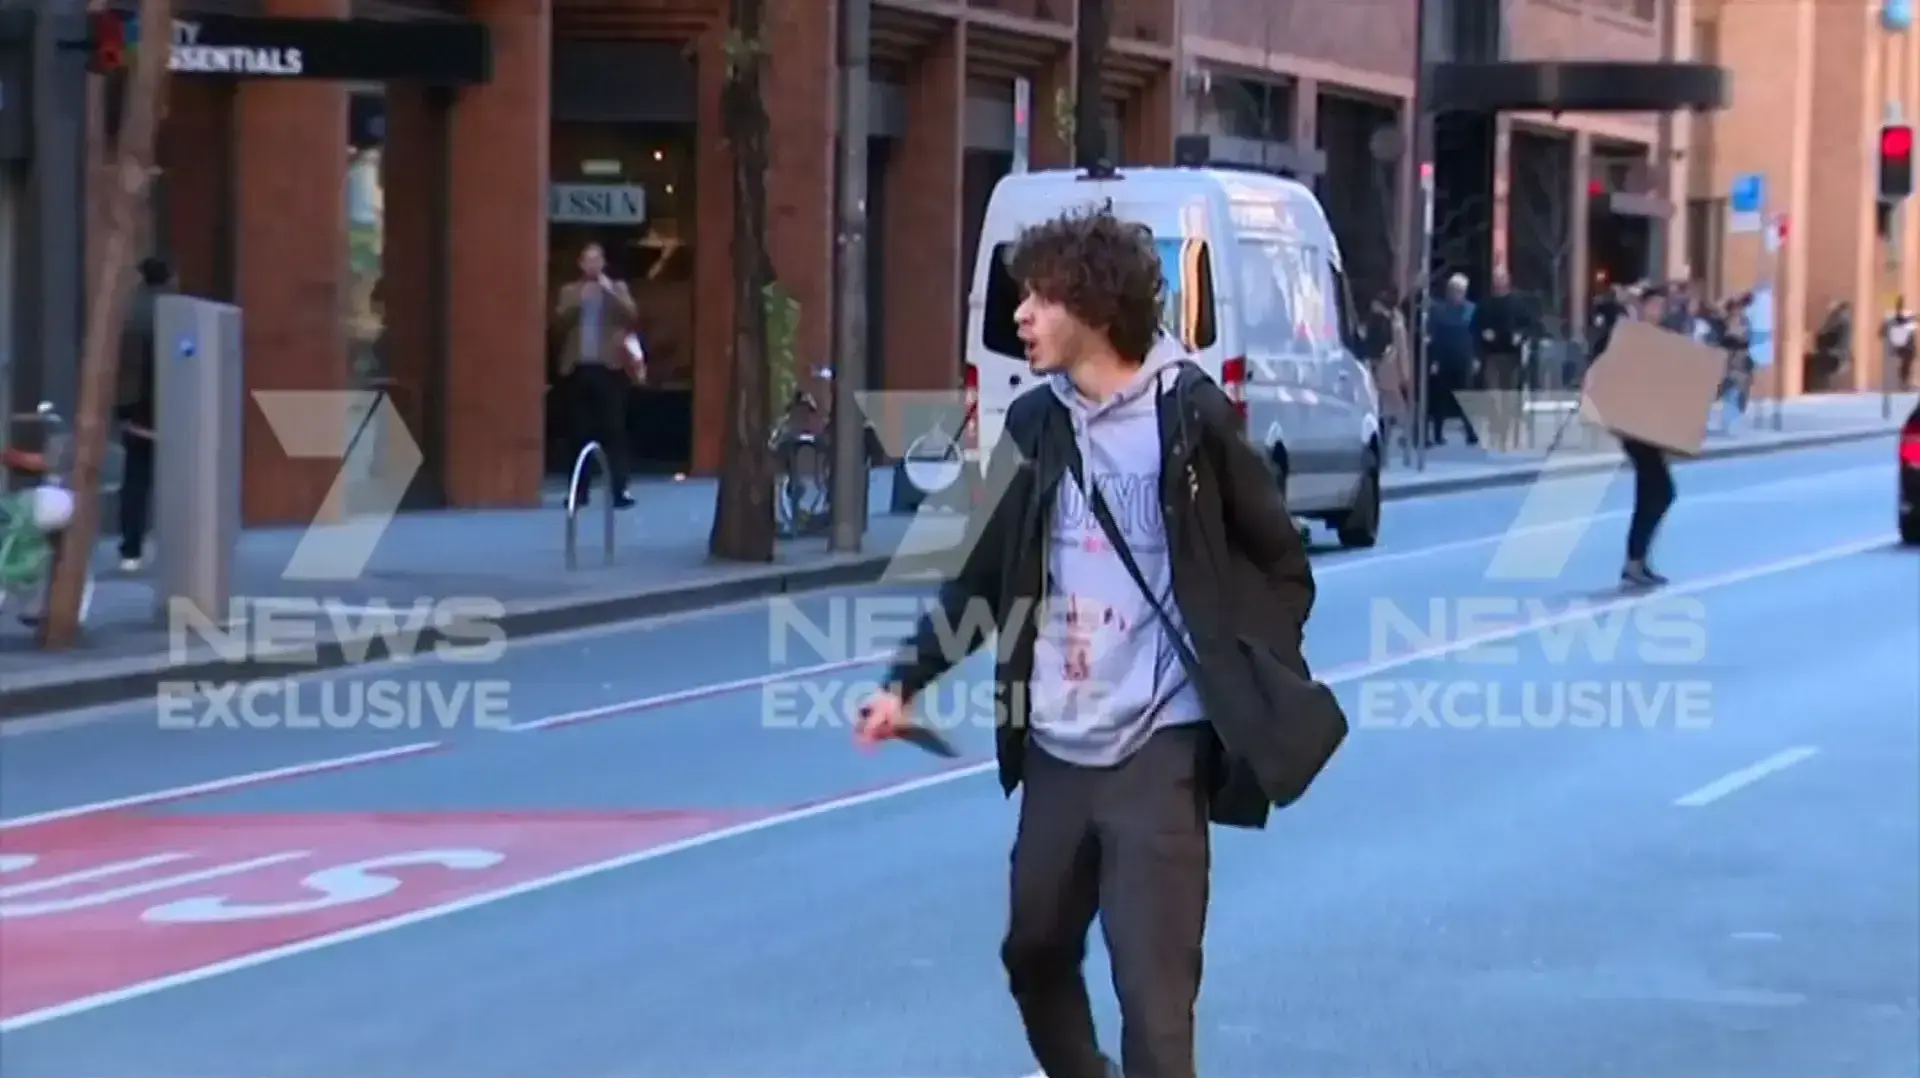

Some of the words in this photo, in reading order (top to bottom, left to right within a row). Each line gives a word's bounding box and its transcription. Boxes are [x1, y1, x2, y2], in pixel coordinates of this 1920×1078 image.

[170, 18, 200, 44] TY
[166, 45, 303, 74] SSENTIALS
[1056, 472, 1165, 538] OYO
[0, 849, 506, 924] US
